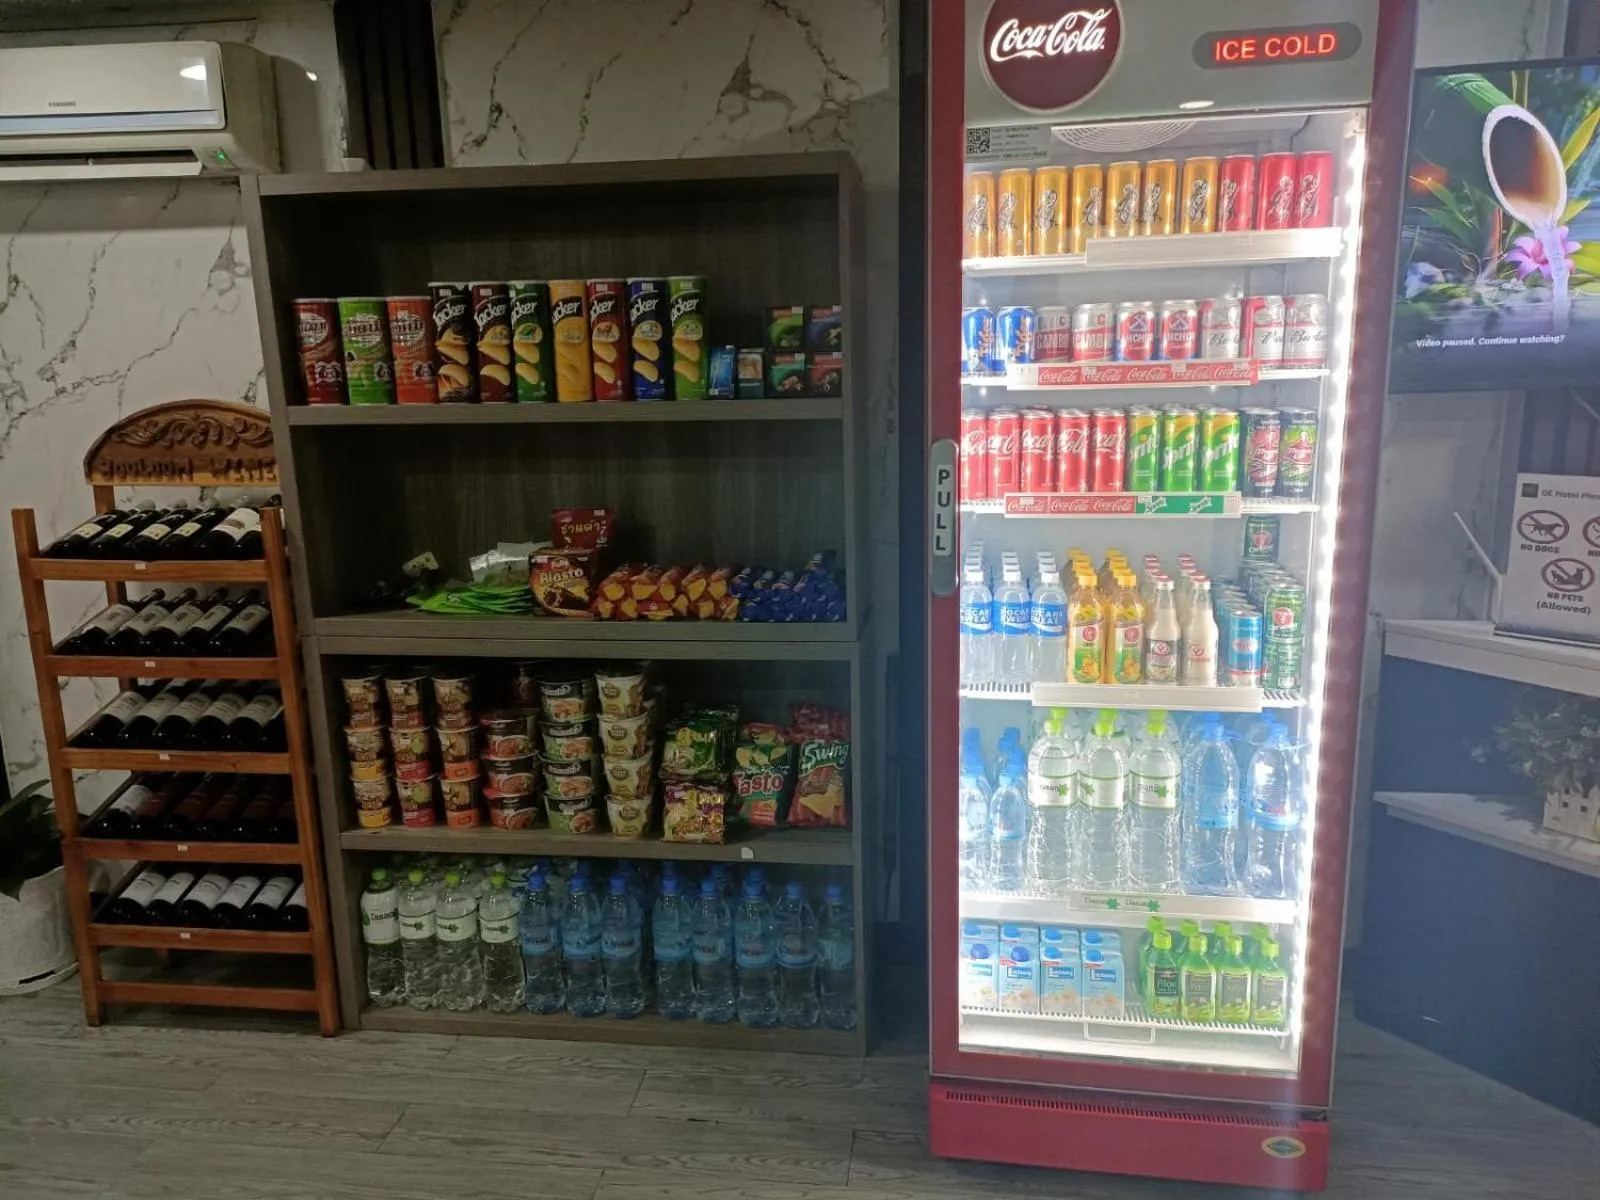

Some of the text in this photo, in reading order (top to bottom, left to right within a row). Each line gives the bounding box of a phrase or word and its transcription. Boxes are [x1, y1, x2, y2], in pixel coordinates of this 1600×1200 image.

[1215, 33, 1337, 61] ICE COLD
[1416, 334, 1566, 348] Video paused. Continue watching?
[936, 469, 950, 551] PULL
[1520, 543, 1533, 551] NO
[1547, 591, 1584, 602] NO PETS
[1536, 601, 1591, 615] (Allowed)
